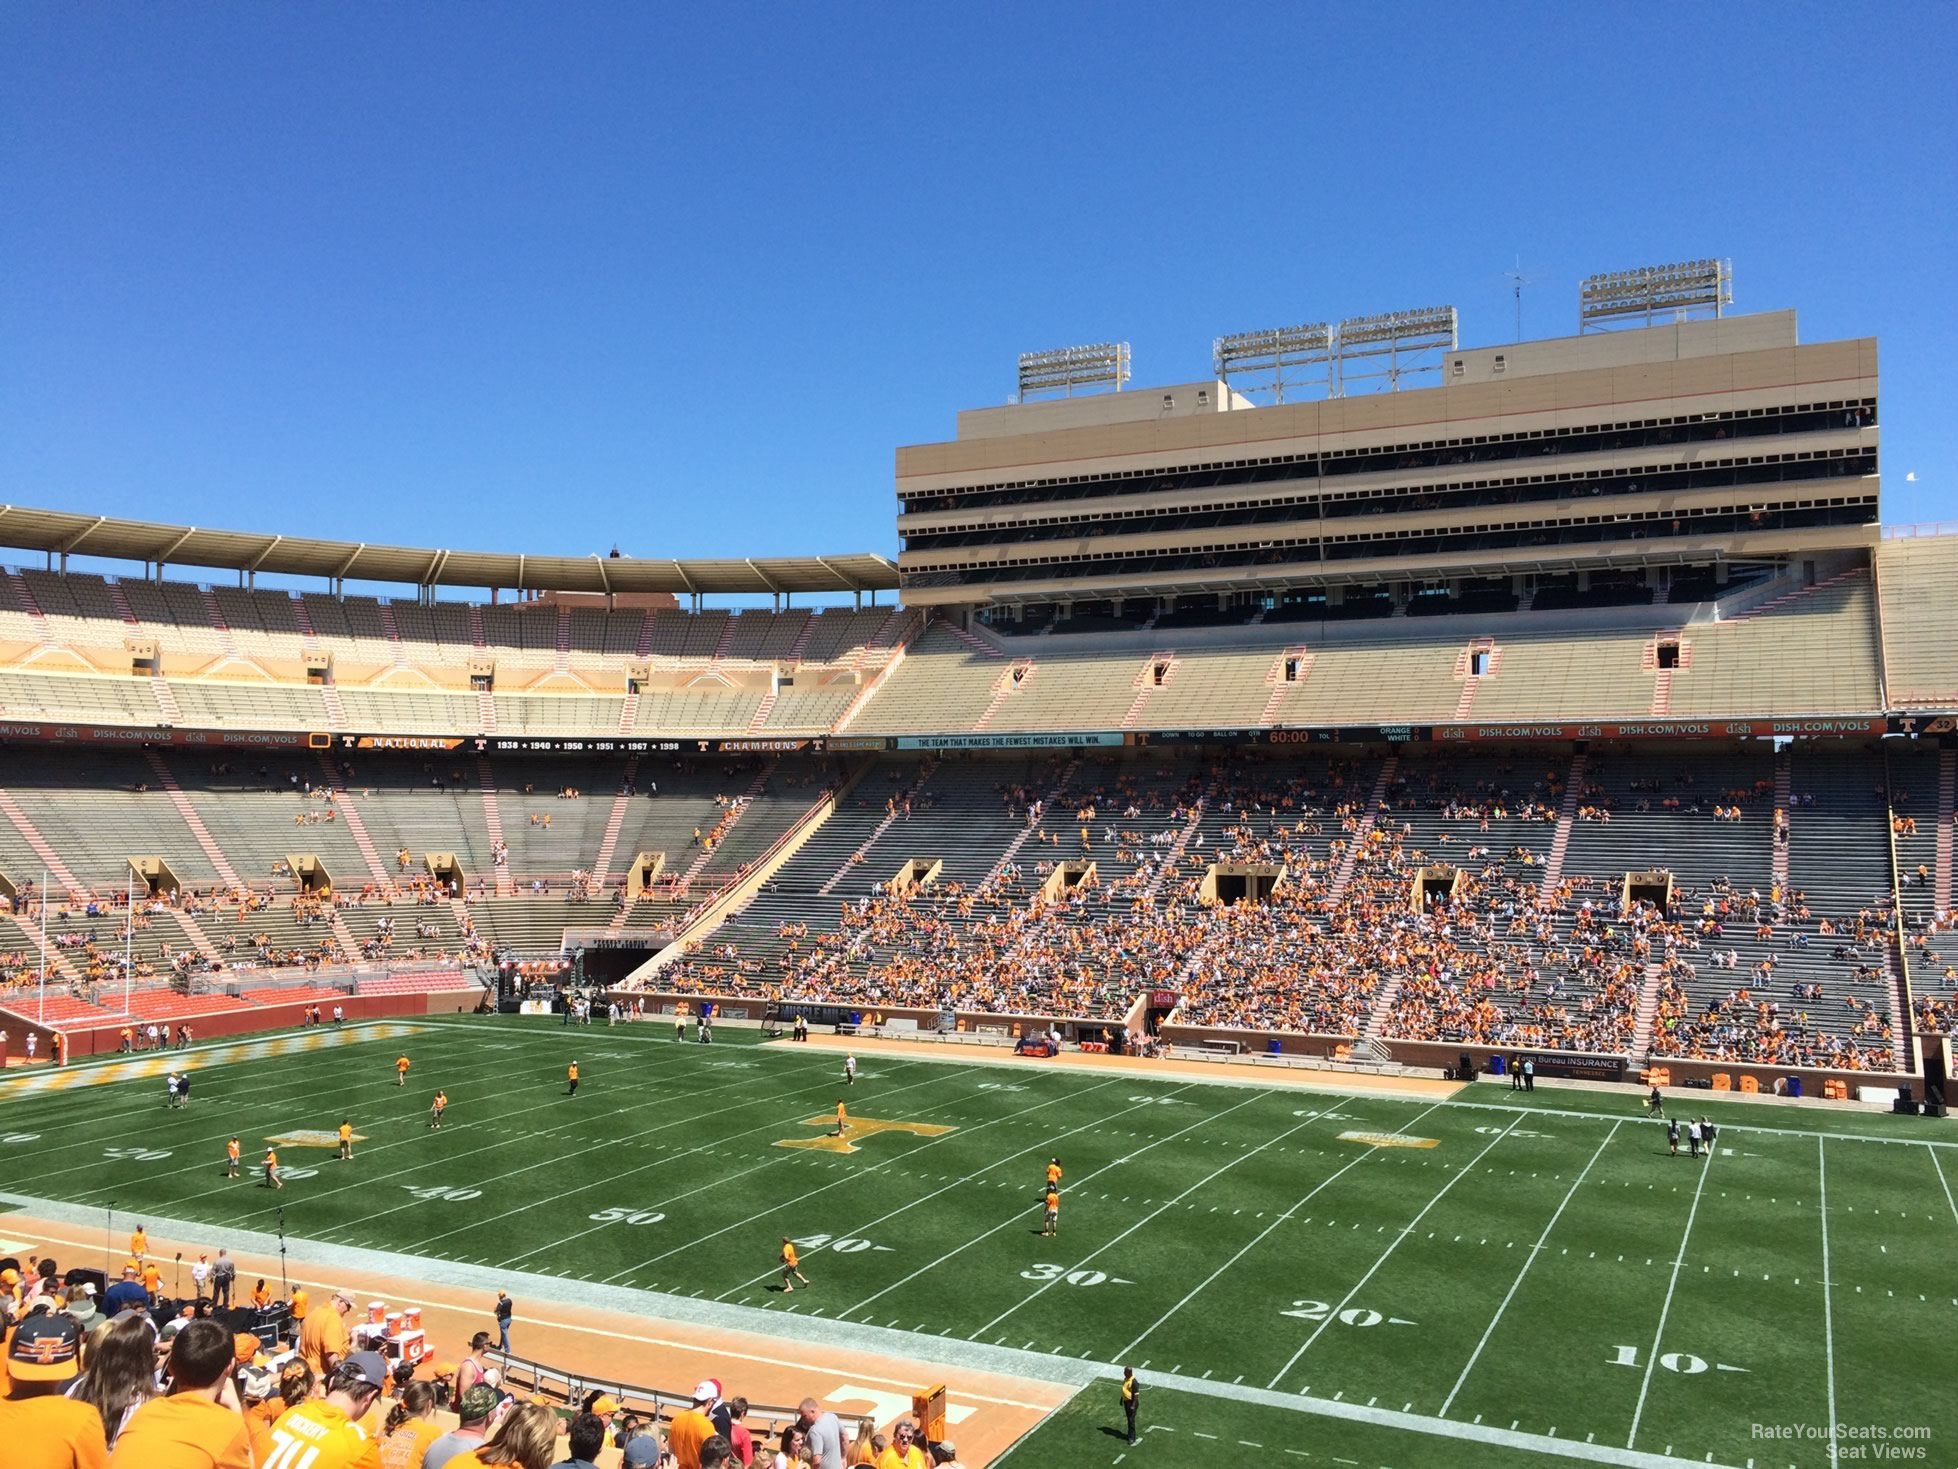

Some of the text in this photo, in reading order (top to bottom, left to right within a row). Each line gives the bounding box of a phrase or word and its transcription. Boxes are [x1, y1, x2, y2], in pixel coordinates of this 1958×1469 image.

[55, 728, 78, 738] dish
[1442, 726, 1465, 739] dish
[1479, 727, 1562, 738] DISH.COM/VOLS
[1578, 725, 1602, 737] dish
[1619, 724, 1709, 735] DISH.COM/VOLS
[1726, 722, 1751, 734] dish
[1773, 722, 1870, 732] DISH.COM/VOLS
[93, 729, 172, 741] DISH.COM/VOLS
[185, 732, 207, 742] dish
[223, 735, 297, 744] DISH.COM/VOLS
[1269, 731, 1309, 743] 60:00
[373, 737, 446, 748] NATIONAL
[497, 741, 679, 751] 1938 1940 1950 1951 1967 1998
[724, 742, 797, 750] CHAMPIONS
[918, 739, 930, 747] THE
[932, 739, 949, 747] TEAM
[969, 738, 991, 746] MAKES
[992, 738, 1004, 746] THE
[1006, 737, 1031, 746] FEWEST
[1033, 736, 1066, 745] MISTAKES
[1068, 736, 1084, 745] WILL
[1154, 993, 1173, 1003] dish
[783, 1005, 820, 1018] MUSCLE
[1538, 1056, 1566, 1065] Bureau
[1567, 1058, 1619, 1068] INSURANCE
[410, 1186, 483, 1201] 40
[588, 1207, 666, 1225] 50
[790, 1234, 871, 1253] 40
[1020, 1263, 1107, 1286] 30
[1279, 1300, 1384, 1327] 20
[409, 1345, 421, 1357] G
[1605, 1345, 1709, 1374] 10
